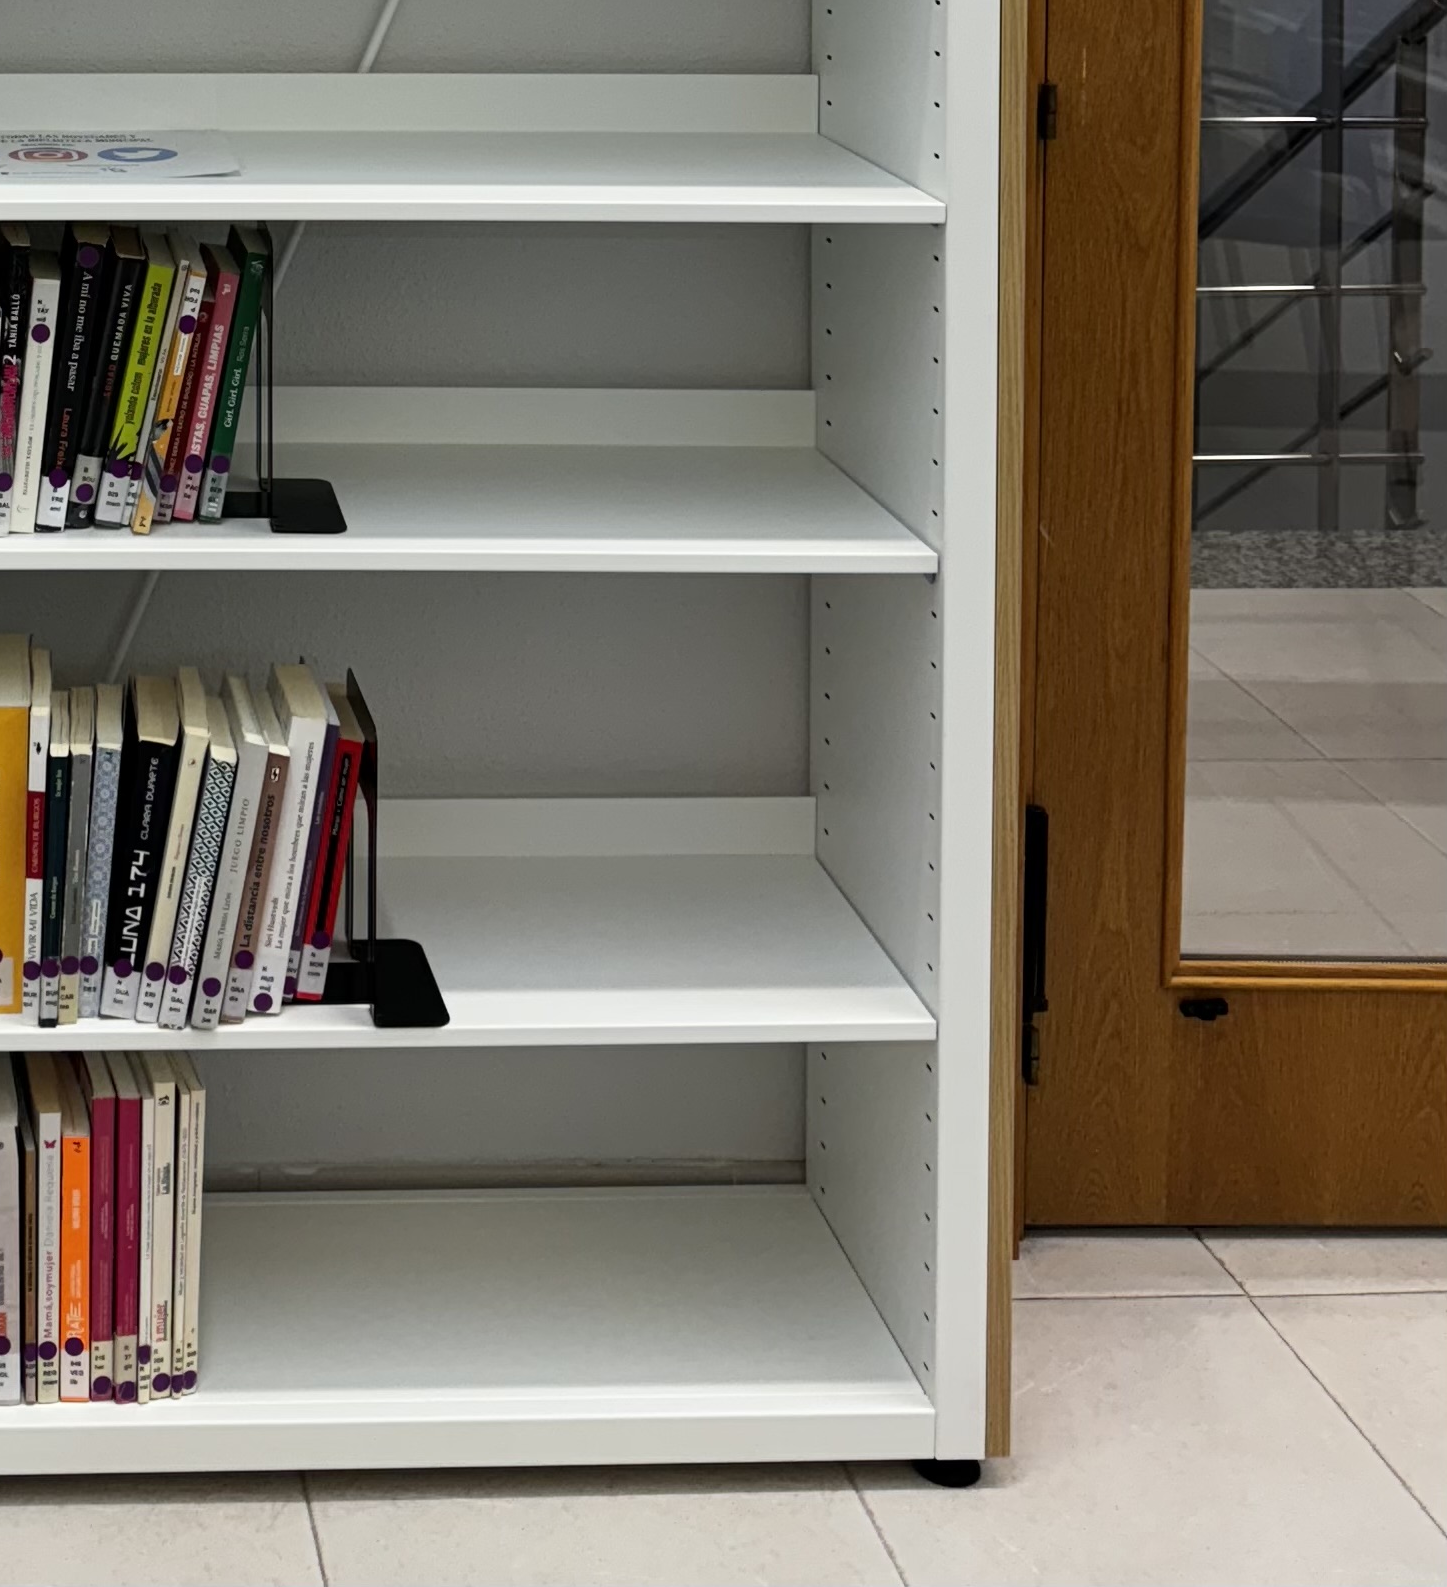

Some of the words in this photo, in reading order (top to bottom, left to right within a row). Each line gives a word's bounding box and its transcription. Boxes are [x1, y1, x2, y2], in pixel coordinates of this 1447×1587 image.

[111, 312, 126, 360] QUEMADA
[120, 284, 133, 308] VIVA
[206, 325, 224, 370] LIMPIAS
[198, 373, 215, 418] GUAPAS,
[145, 757, 159, 801] DUARTE
[140, 804, 153, 840] CLARA
[259, 794, 275, 844] nosotros
[124, 849, 151, 898] 174
[253, 848, 265, 879] entre
[243, 881, 261, 931] distancia
[120, 905, 142, 965] LUNA
[239, 934, 252, 948] La
